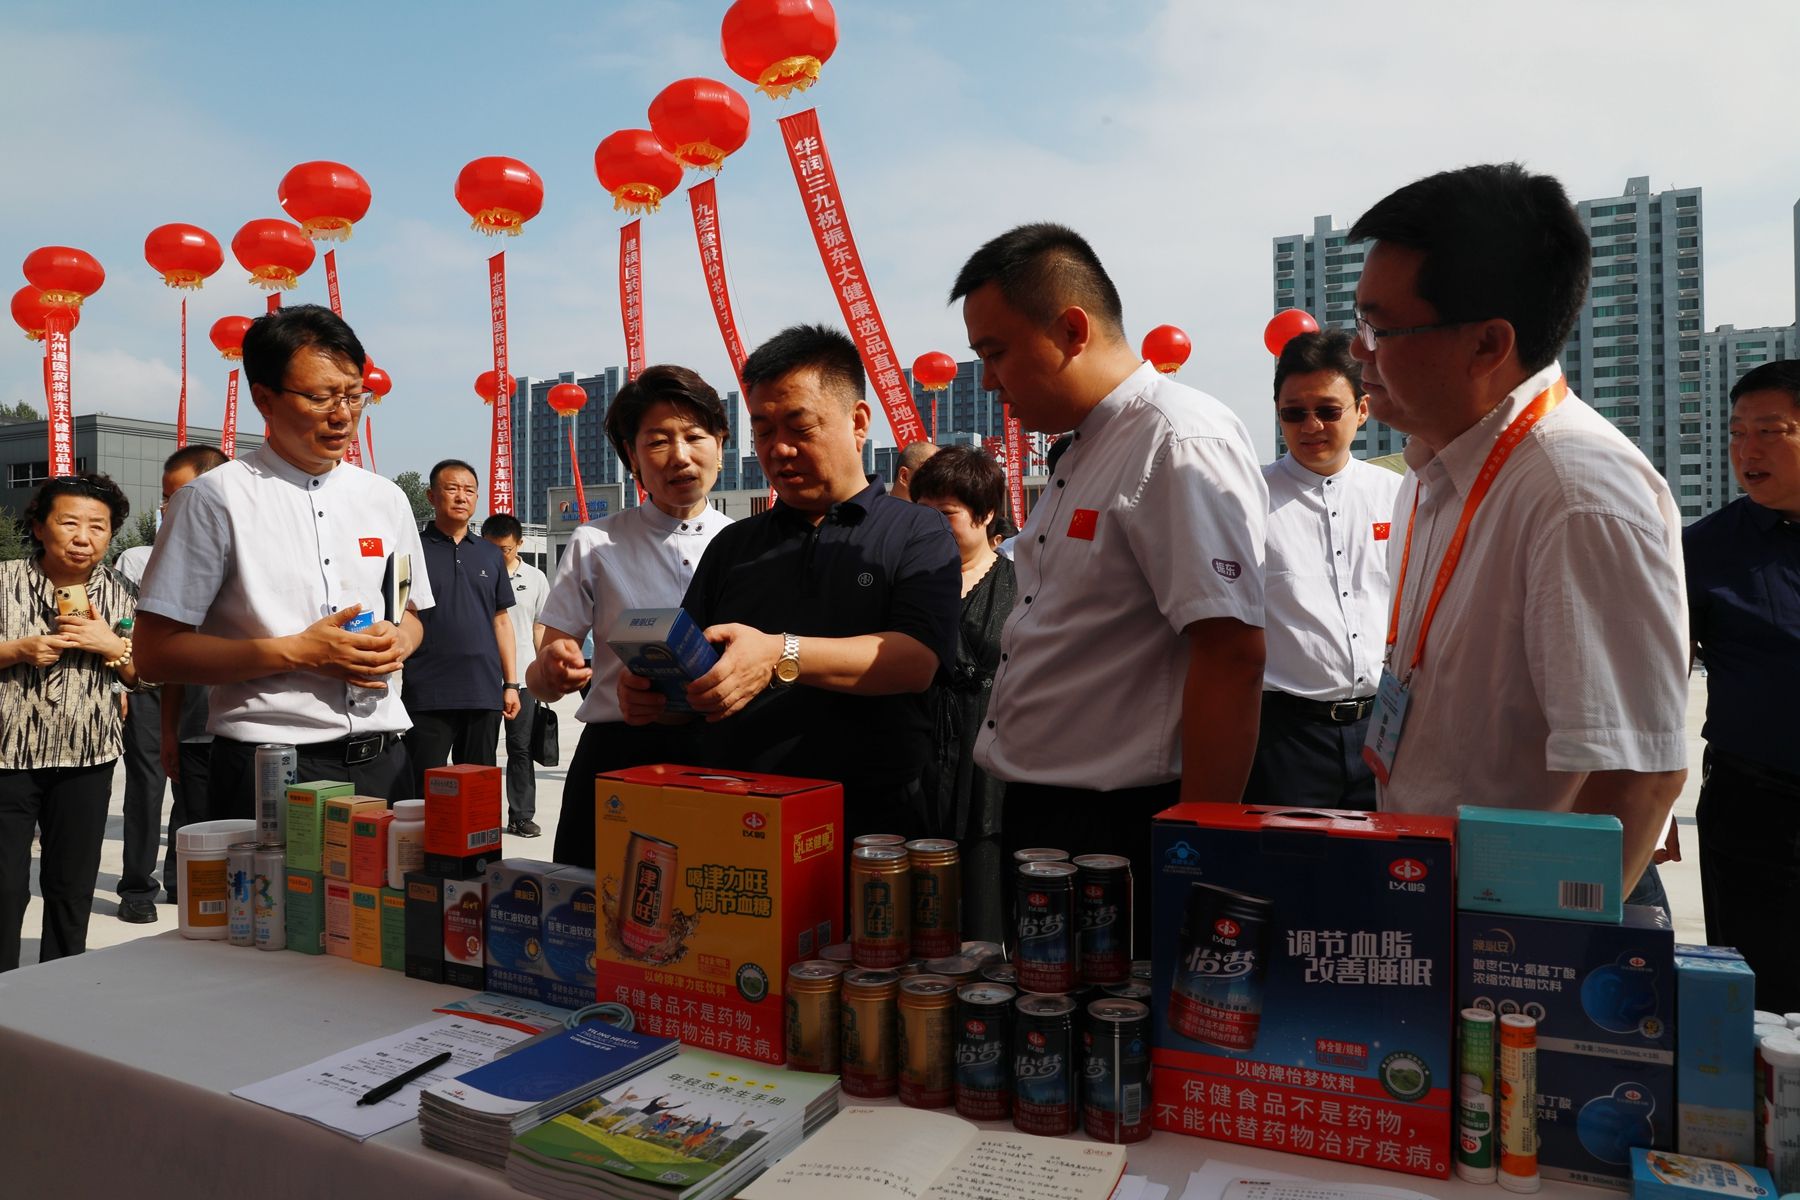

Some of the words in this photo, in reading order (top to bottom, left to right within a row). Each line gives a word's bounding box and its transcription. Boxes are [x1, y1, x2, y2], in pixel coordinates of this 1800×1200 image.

[795, 136, 920, 443] 华润三九祝振东大健康选品直播基地开
[1216, 560, 1236, 577] 振东
[687, 864, 767, 893] 喝津力旺
[1388, 880, 1426, 893] 以岭
[696, 888, 772, 917] 调节血糖
[1018, 912, 1065, 940] 怡梦
[1286, 929, 1413, 958] 调节血脂
[1185, 947, 1257, 977] 怡梦
[1304, 957, 1433, 986] 改善睡眠
[615, 984, 762, 1034] 保健食品不是药物，
[955, 1040, 1003, 1067] 怡梦
[1015, 1053, 1063, 1081] 怡梦
[667, 1073, 787, 1107] 年轻态养生手册
[1235, 1060, 1356, 1093] 以岭牌怡梦饮料
[1182, 1078, 1417, 1139] 保健食品不是药物，
[1157, 1102, 1446, 1173] 不能代替药物治疗疾病。
